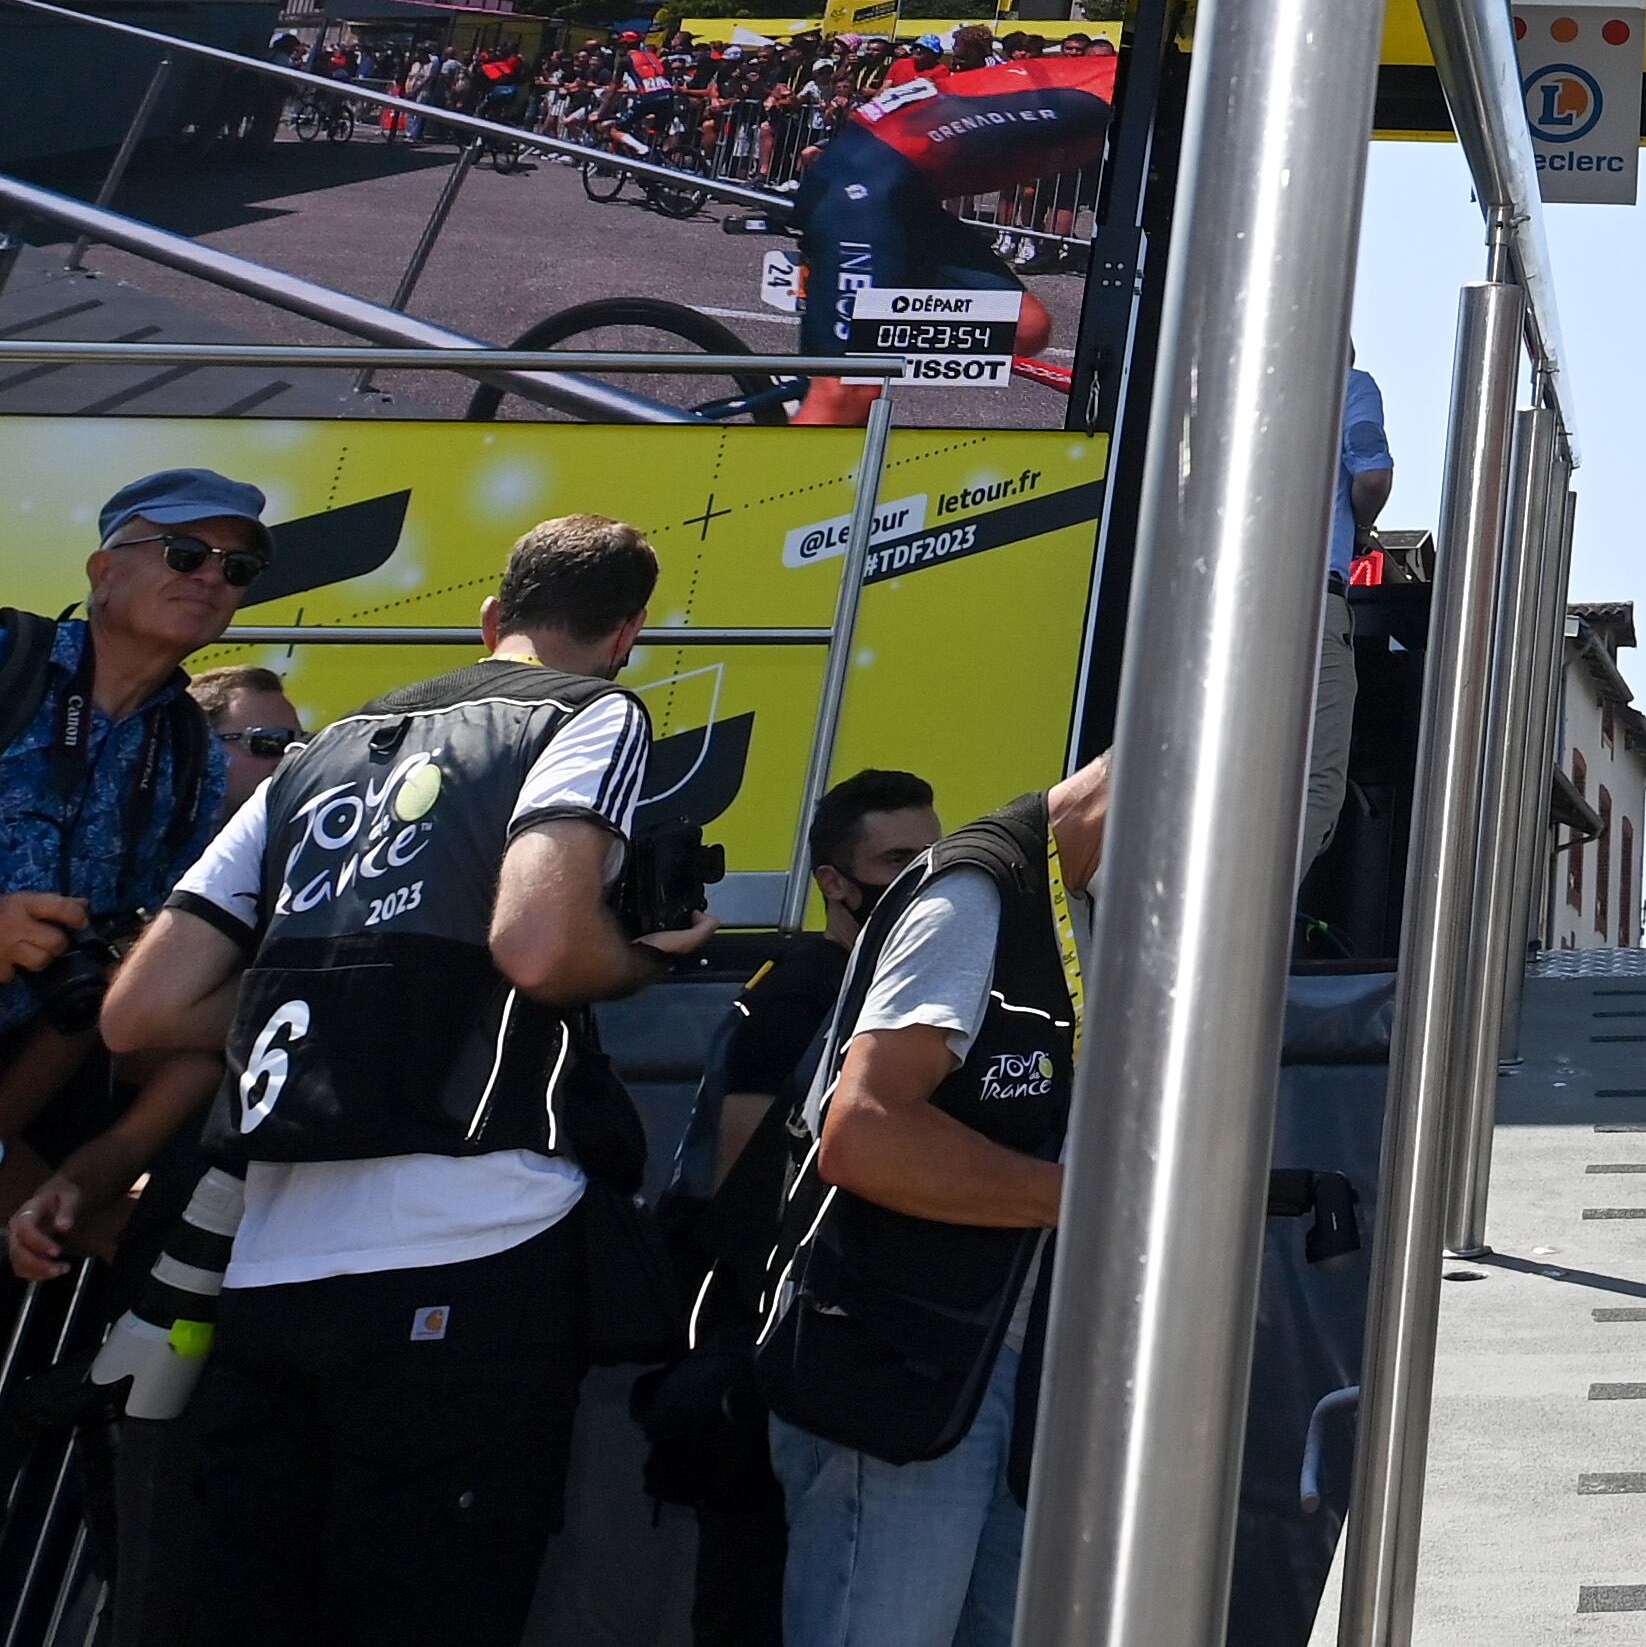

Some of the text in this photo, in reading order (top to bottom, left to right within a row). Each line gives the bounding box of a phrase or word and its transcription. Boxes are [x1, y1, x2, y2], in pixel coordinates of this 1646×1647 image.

[927, 107, 1058, 144] GRENADIER
[1534, 152, 1625, 173] eclerc
[911, 294, 973, 314] DÉPART
[876, 324, 992, 350] 00:23:54
[906, 359, 1006, 381] ISSOT
[936, 468, 1042, 517] letour.fr
[800, 508, 910, 559] @Leour
[863, 523, 977, 579] #TDF2023
[64, 694, 84, 747] Canon
[364, 880, 424, 927] 2023
[239, 999, 311, 1135] 6
